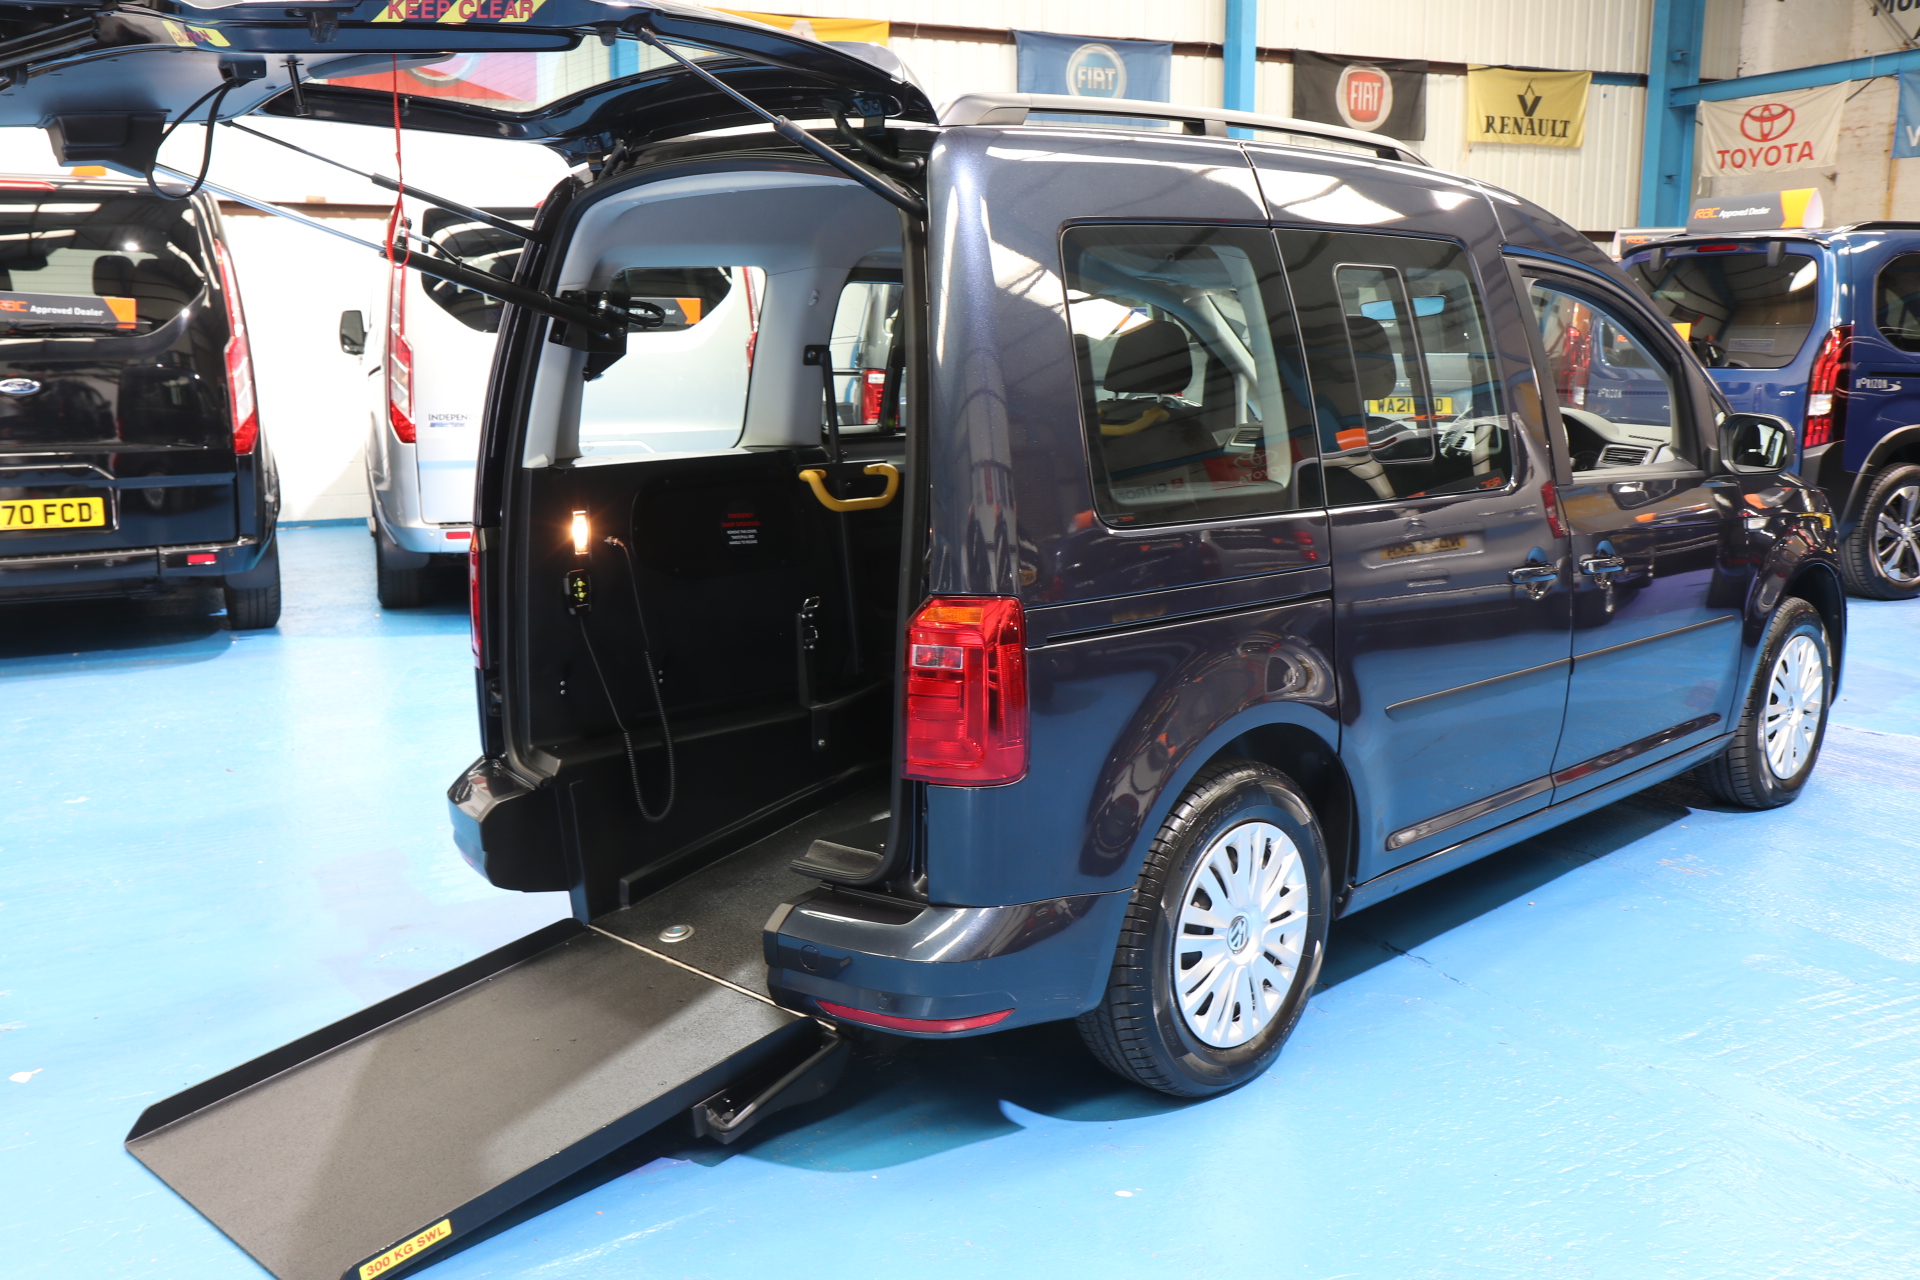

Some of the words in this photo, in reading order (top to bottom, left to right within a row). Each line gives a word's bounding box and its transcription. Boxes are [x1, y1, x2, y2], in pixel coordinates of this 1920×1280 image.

[388, 0, 450, 19] KEEP
[458, 0, 534, 19] CLEAR
[1077, 66, 1116, 90] FIAT
[1350, 81, 1381, 111] FIAT
[1484, 116, 1571, 138] RENAULT
[1716, 140, 1815, 169] TOYOTA
[1719, 208, 1748, 219] Approved
[1748, 206, 1771, 216] Dealer
[30, 305, 72, 314] Approved
[74, 307, 104, 316] Dealer
[43, 503, 92, 524] FCD
[366, 1256, 390, 1276] 300
[394, 1243, 413, 1260] KG
[417, 1227, 445, 1247] SWL
